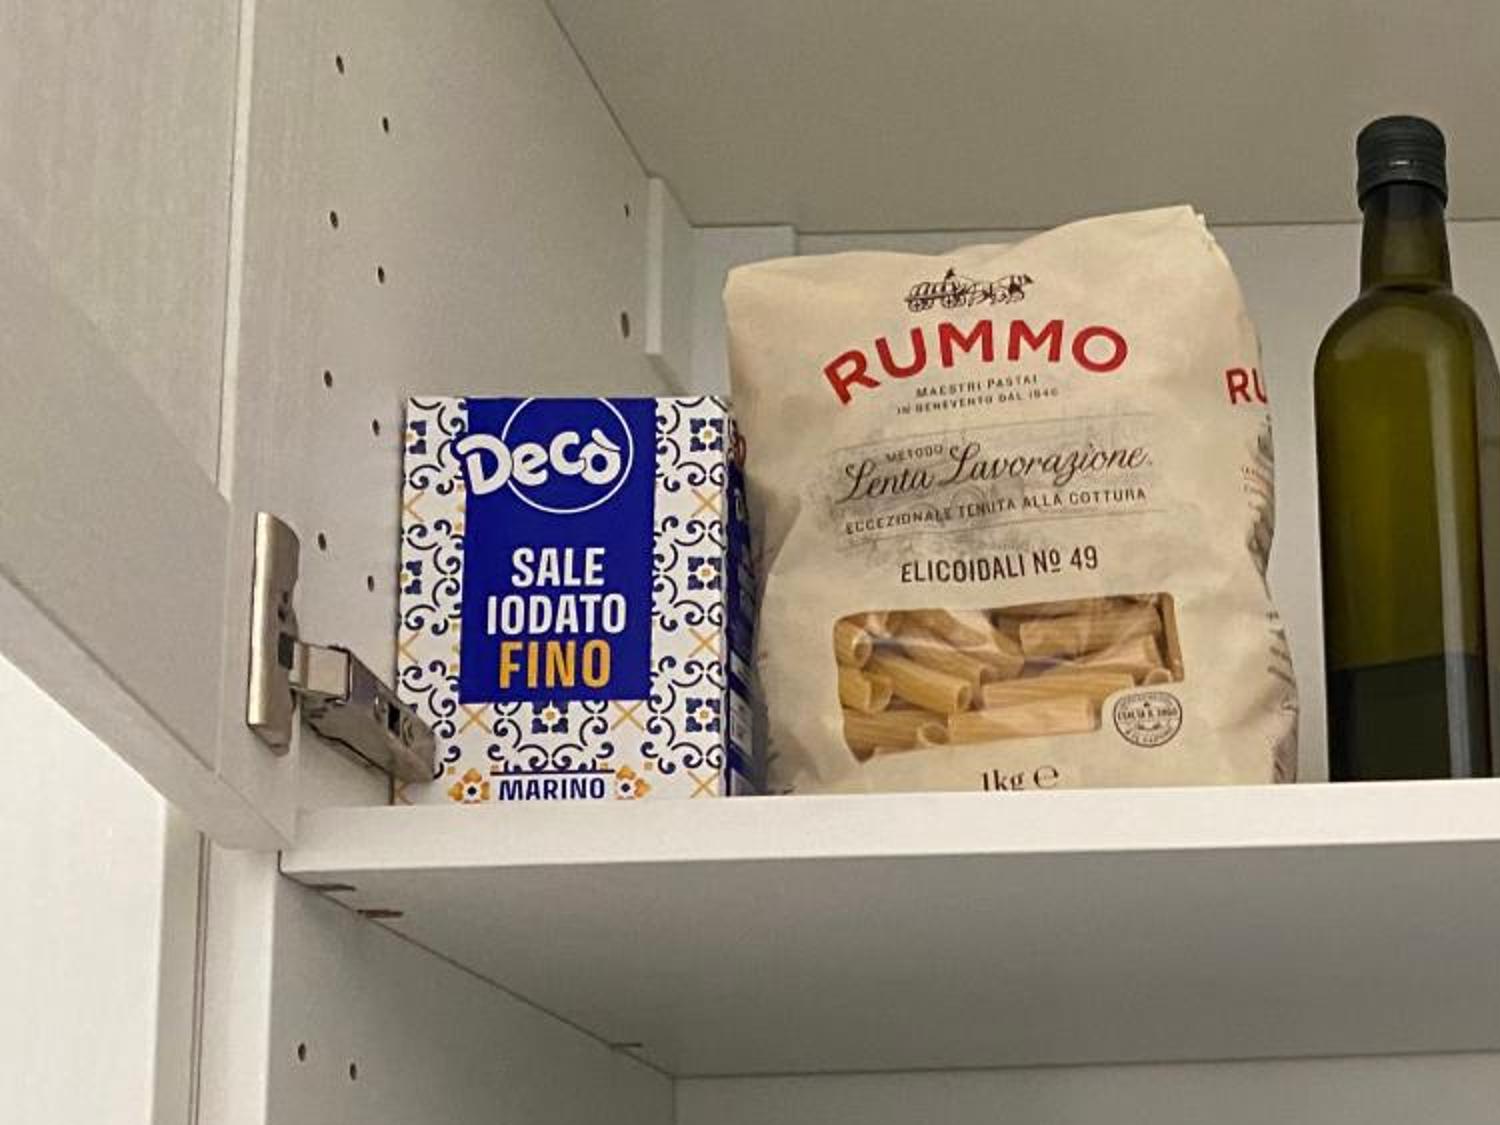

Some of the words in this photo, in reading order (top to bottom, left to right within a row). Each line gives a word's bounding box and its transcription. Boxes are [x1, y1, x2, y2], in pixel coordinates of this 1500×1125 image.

[824, 320, 1128, 405] RUMMO
[897, 405, 912, 416] IN
[915, 396, 993, 413] BENEVENTO
[997, 393, 1022, 403] DAL
[916, 383, 981, 398] MAESTRI
[987, 375, 1038, 389] PASTAI
[456, 429, 621, 495] Decò
[834, 458, 934, 505] Lenta
[939, 441, 1149, 487] Lavorazione
[886, 444, 943, 463] METODO
[846, 507, 952, 535] ECCEZIONALE
[958, 500, 1015, 519] TENUTA
[1023, 495, 1062, 510] ALLA
[1069, 487, 1147, 505] COTTURA
[511, 547, 605, 587] SALE
[901, 557, 1025, 584] ELICOIDALI
[1070, 545, 1098, 570] 49
[487, 592, 626, 635] IODATO
[499, 639, 612, 689] FINO
[499, 776, 605, 801] MARINO
[982, 769, 1026, 790] 1kg
